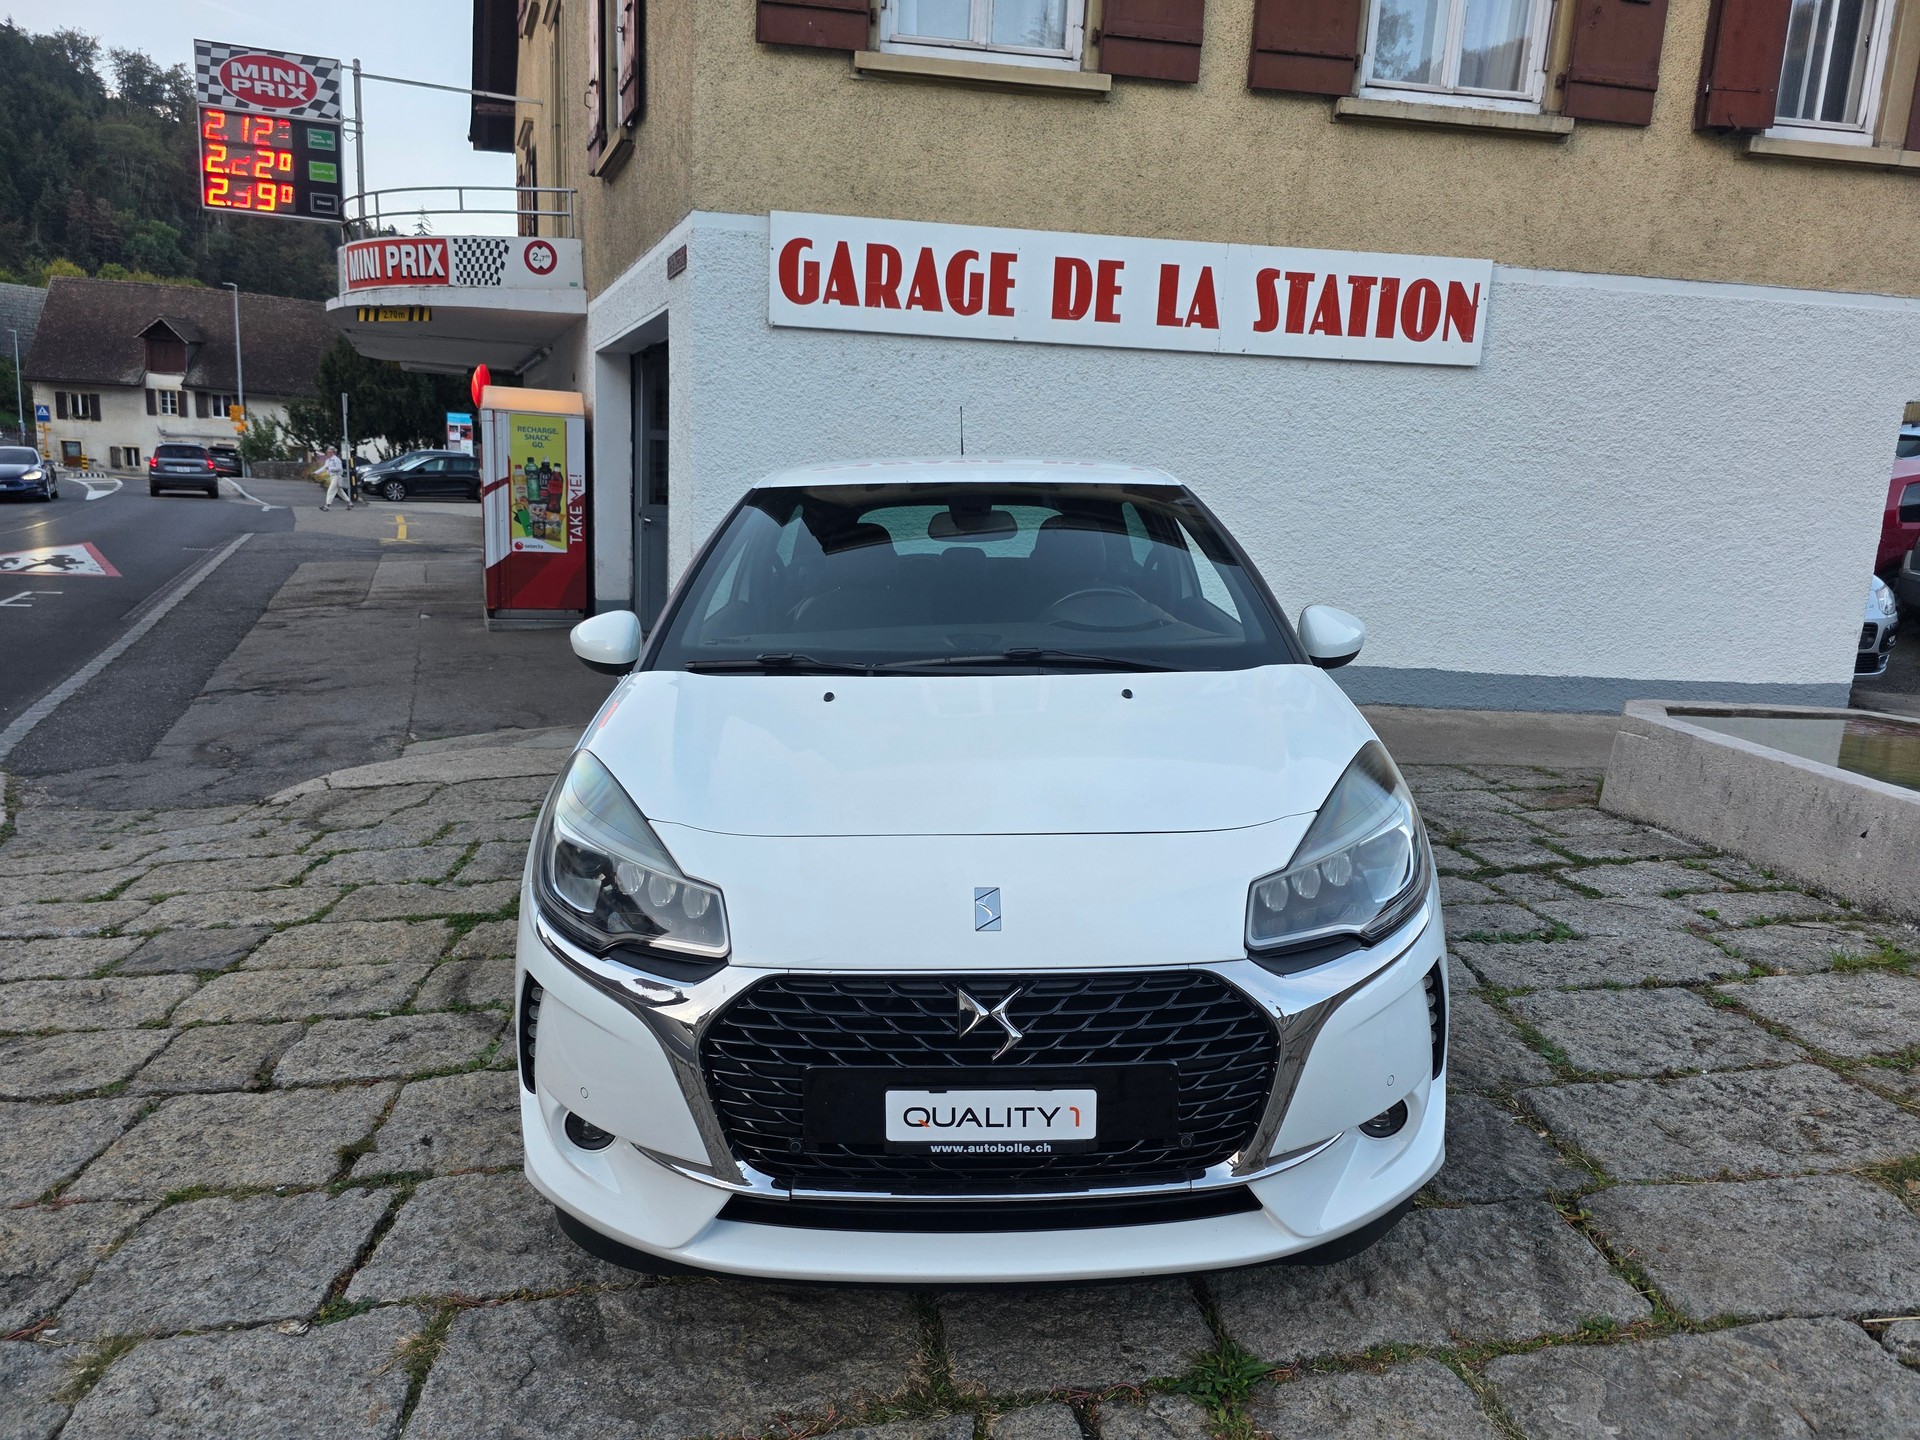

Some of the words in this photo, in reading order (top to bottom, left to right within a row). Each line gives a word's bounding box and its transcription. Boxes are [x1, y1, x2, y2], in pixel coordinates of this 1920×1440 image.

[230, 61, 307, 86] MINI
[231, 77, 308, 101] PRIX
[348, 246, 381, 282] MINI
[385, 244, 446, 279] PRIX
[778, 237, 1018, 317] GARAGE
[1051, 256, 1125, 323] DE
[1156, 263, 1220, 330] LA
[1252, 267, 1481, 343] STATION
[517, 425, 559, 435] RECHARGE.
[524, 433, 551, 442] SNACK.
[532, 441, 545, 449] GO.
[569, 474, 583, 501] ME!
[569, 505, 583, 545] TAKE
[903, 1106, 1061, 1128] QUALITY
[1069, 1106, 1080, 1127] 1
[930, 1143, 1052, 1153] www.autobolle.ch
